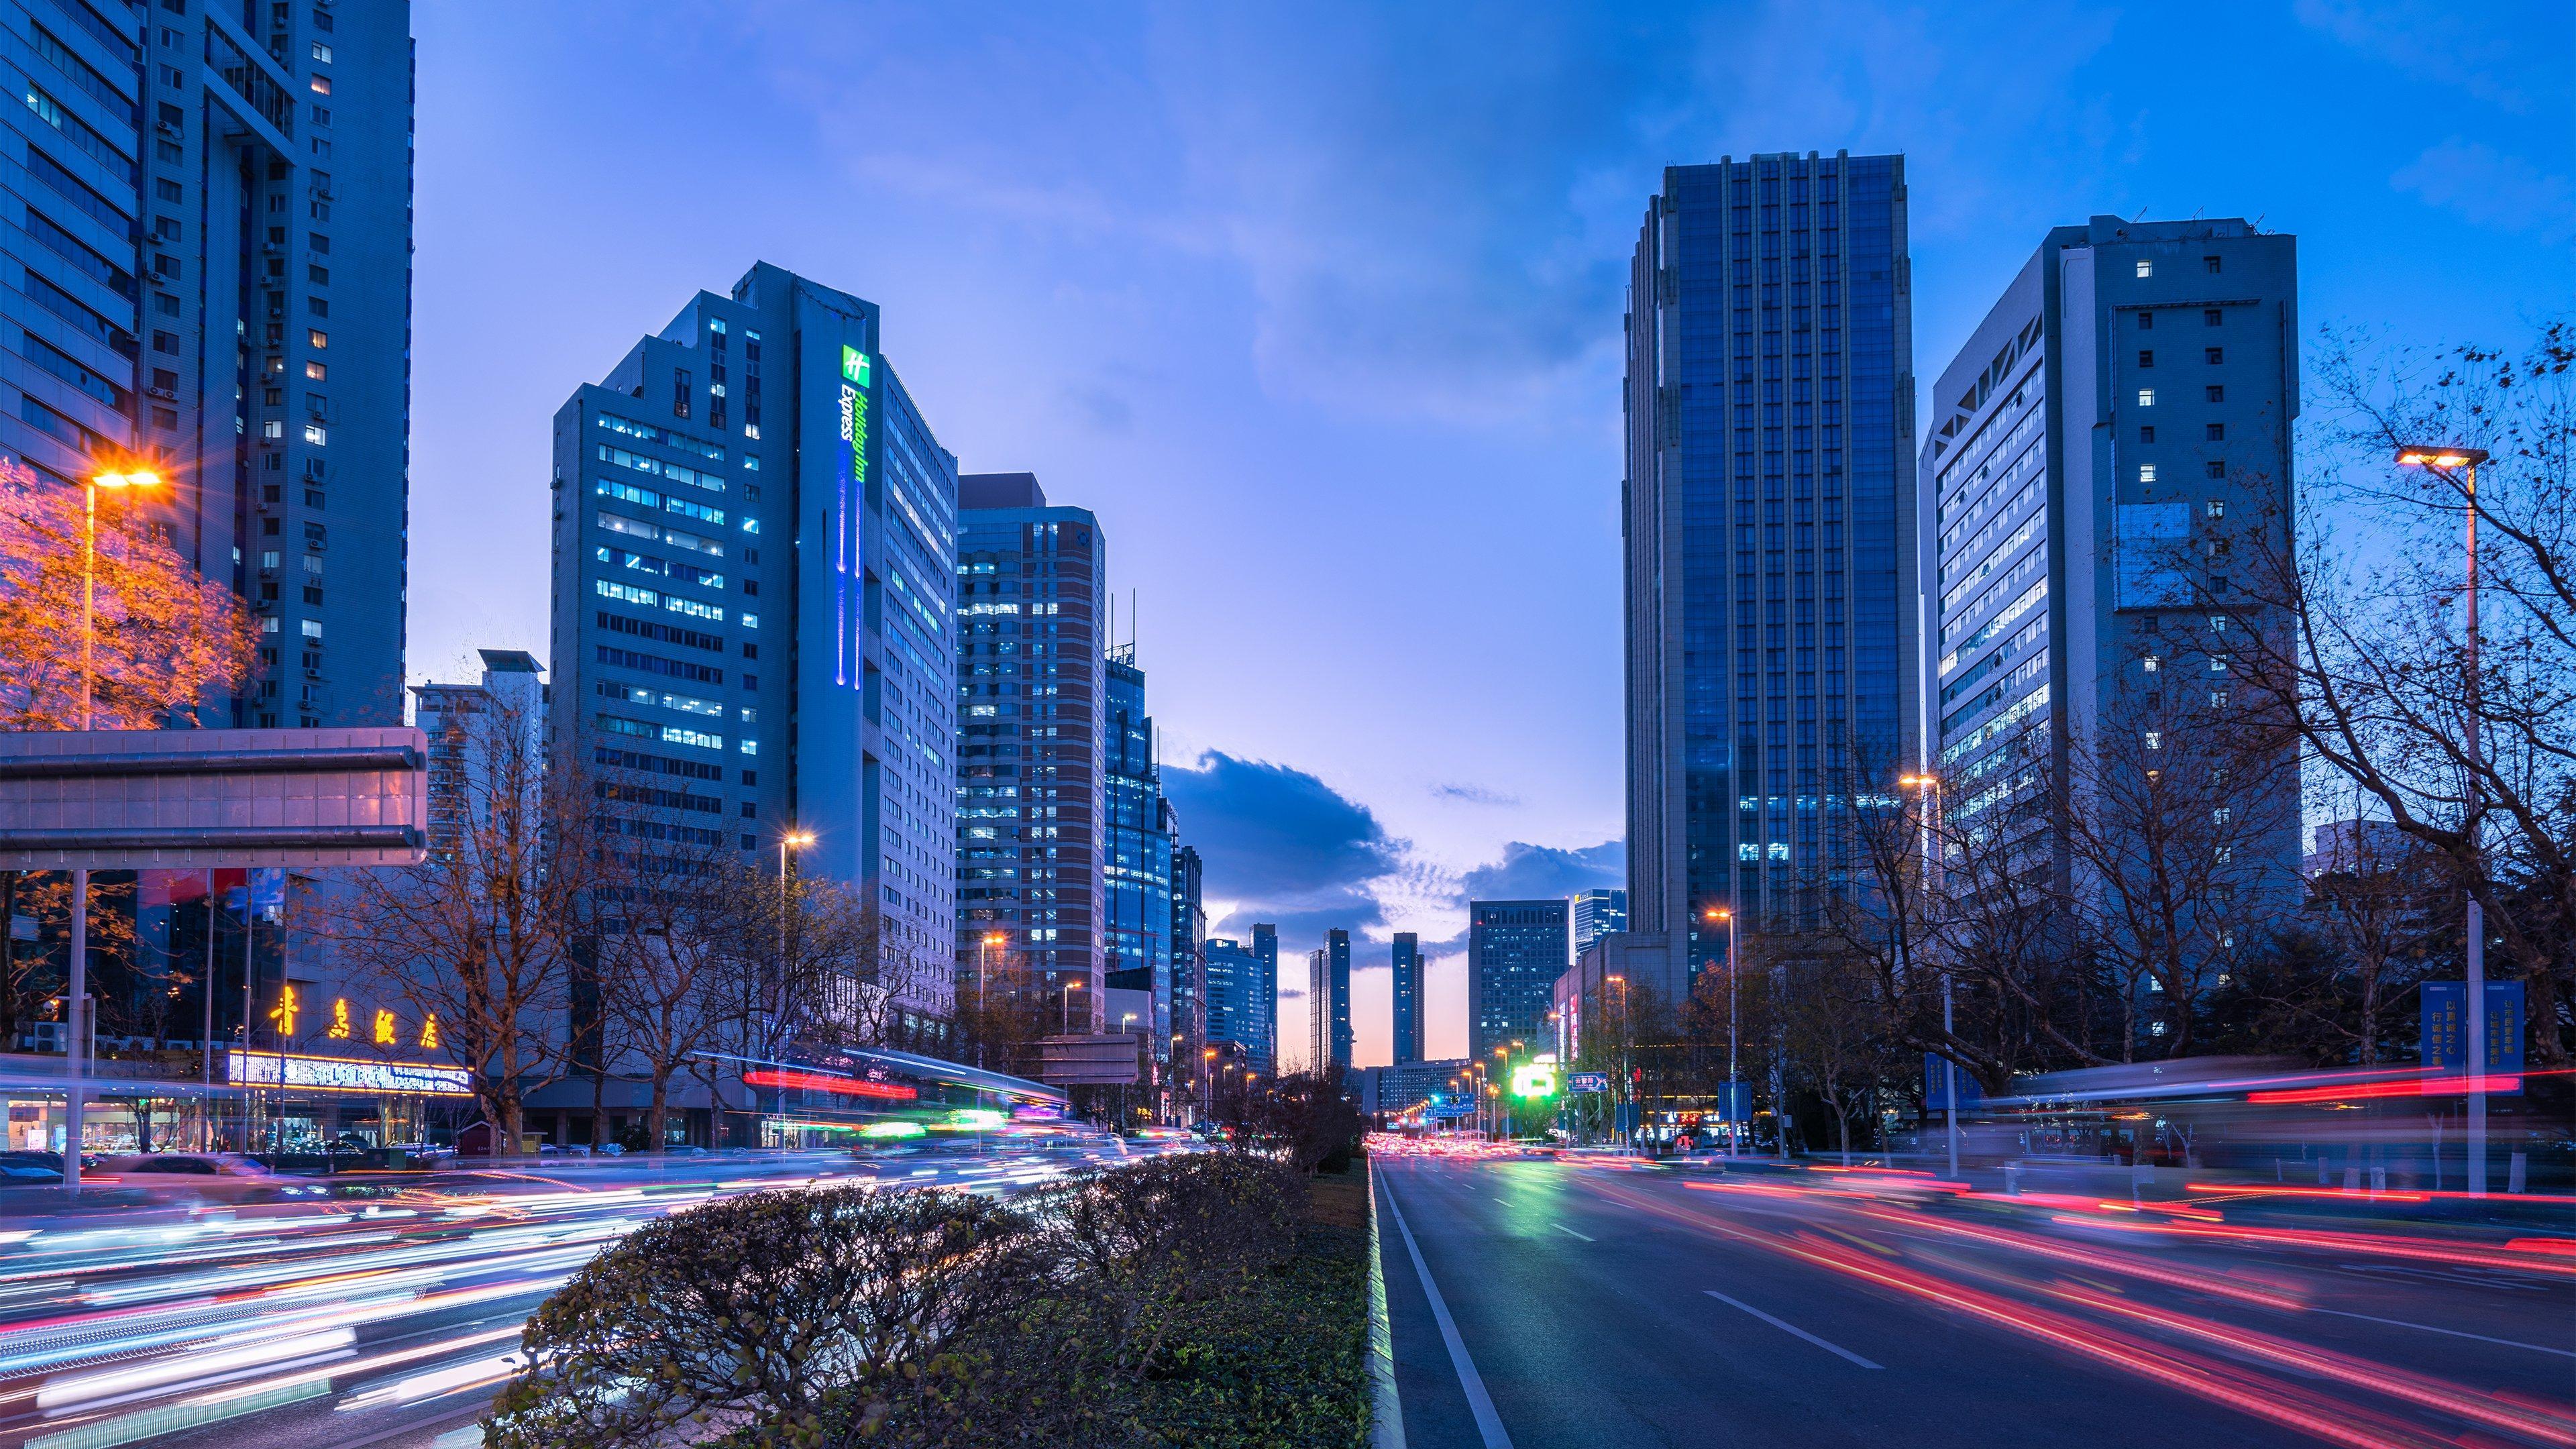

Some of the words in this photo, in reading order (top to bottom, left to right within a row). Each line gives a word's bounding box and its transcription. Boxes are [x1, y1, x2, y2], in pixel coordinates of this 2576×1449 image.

[838, 384, 856, 443] Express
[852, 390, 869, 457] Holiday
[855, 454, 869, 484] Inn
[2446, 1000, 2457, 1055] 以真诚之心
[2489, 1011, 2500, 1065] 让城市更美好
